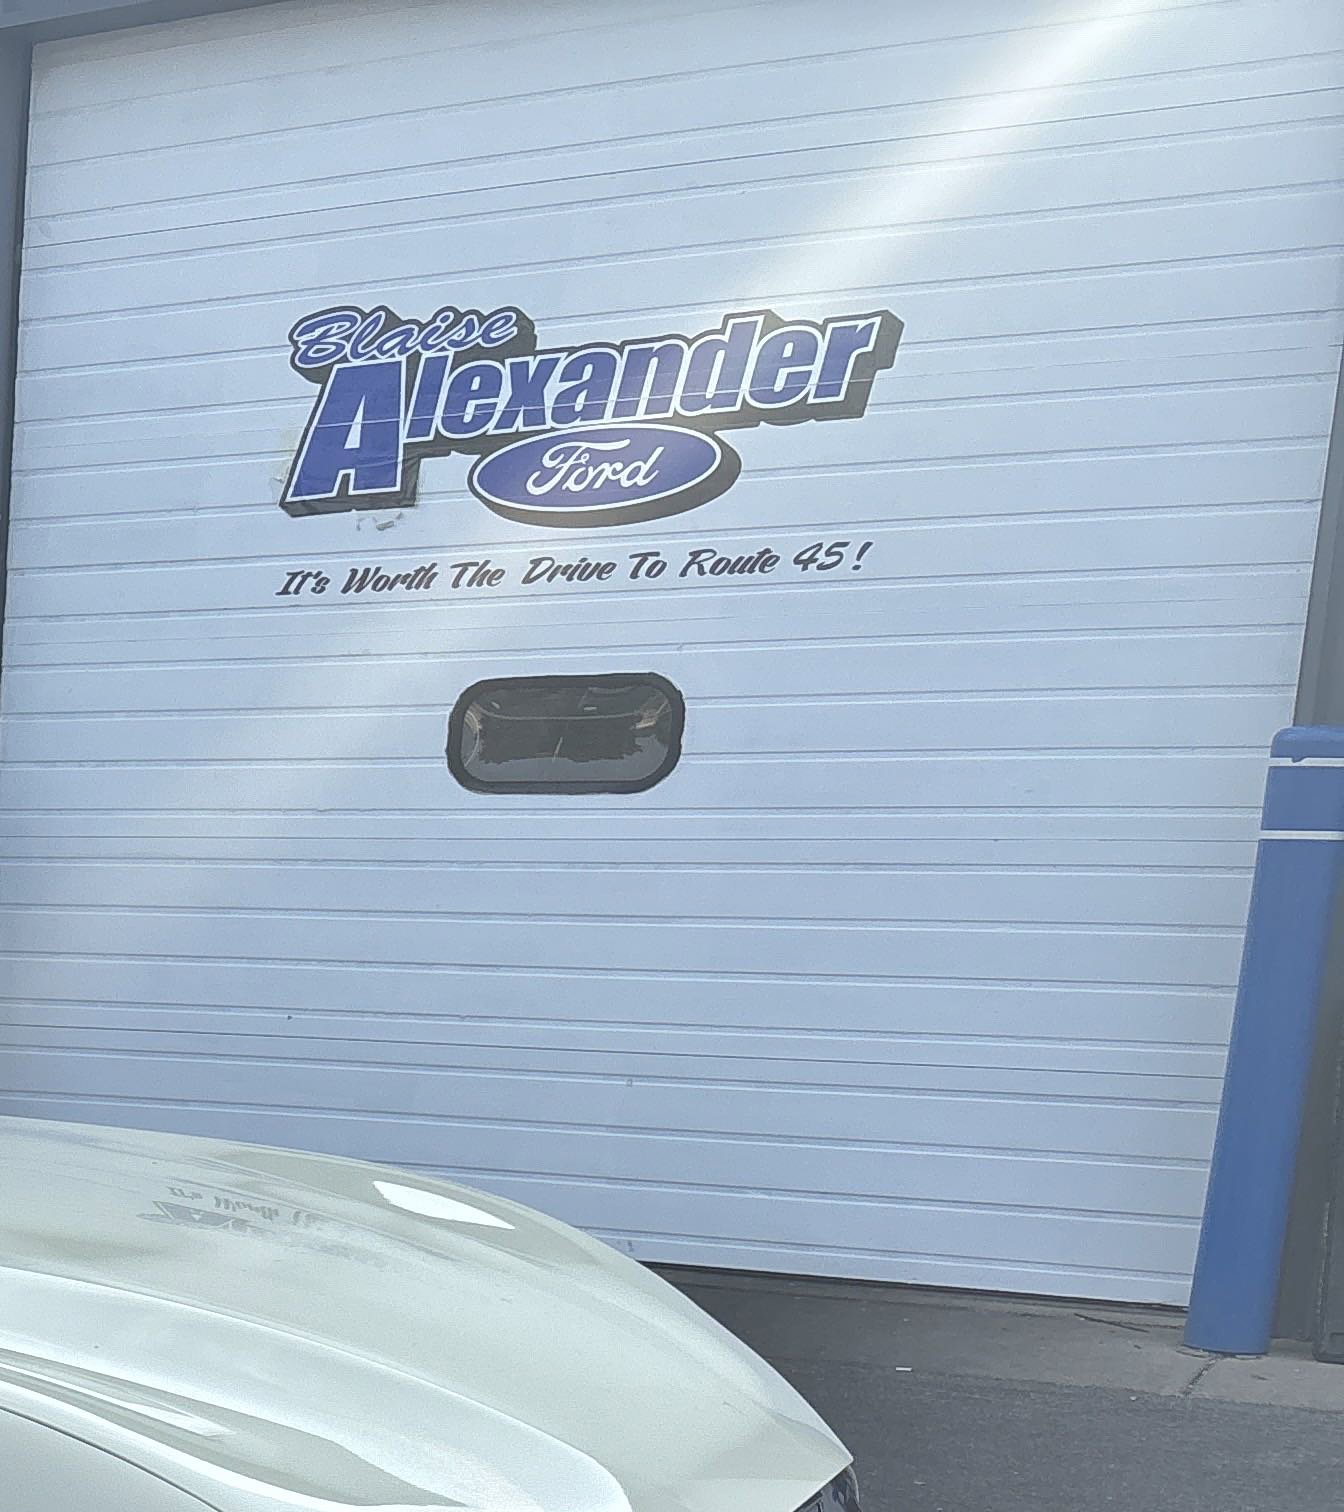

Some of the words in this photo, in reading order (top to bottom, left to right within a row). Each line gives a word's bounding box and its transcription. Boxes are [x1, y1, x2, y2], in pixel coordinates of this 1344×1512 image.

[293, 310, 518, 369] Blaise
[288, 314, 881, 501] Alexander
[525, 438, 665, 496] Ford
[275, 569, 331, 596] It's
[340, 562, 439, 595] Worth
[450, 559, 506, 590] The
[521, 556, 617, 585] Drive
[628, 551, 668, 580] To
[678, 547, 781, 578] Route
